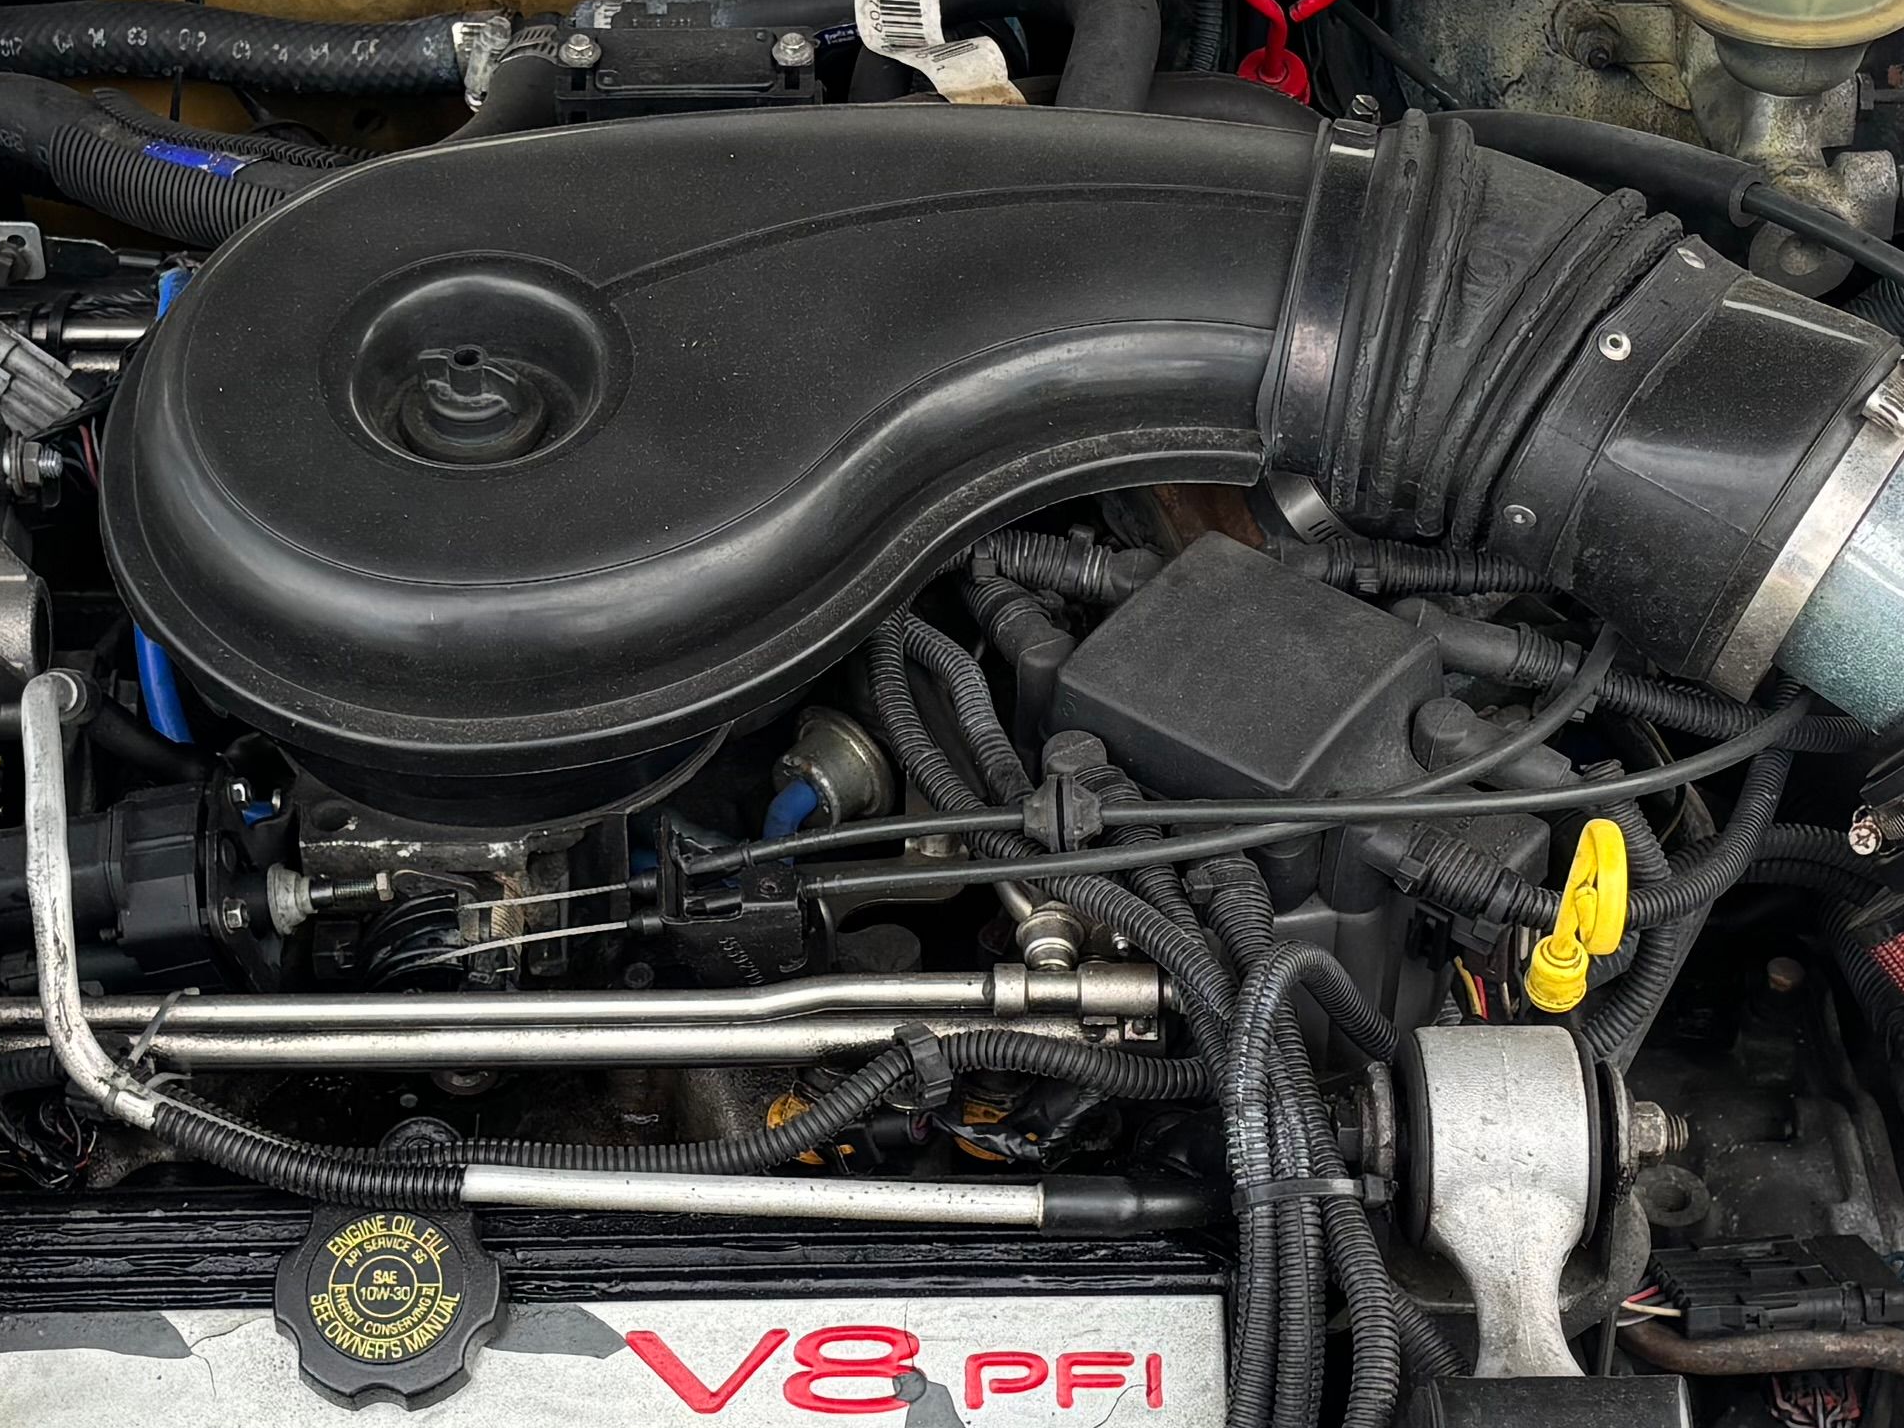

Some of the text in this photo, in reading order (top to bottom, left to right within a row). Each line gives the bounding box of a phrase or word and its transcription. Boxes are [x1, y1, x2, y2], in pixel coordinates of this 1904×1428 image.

[326, 1215, 449, 1260] ENGINE OIL FILL
[344, 1247, 363, 1268] API
[363, 1237, 412, 1253] SERVICE
[360, 1287, 410, 1301] 10W-30
[372, 1270, 398, 1285] SAE
[310, 1292, 461, 1359] SEE OWNER'S MANUAL
[334, 1286, 364, 1327] ENERGY
[363, 1298, 432, 1336] CONSERVING
[624, 1325, 1164, 1415] V8 PFI
